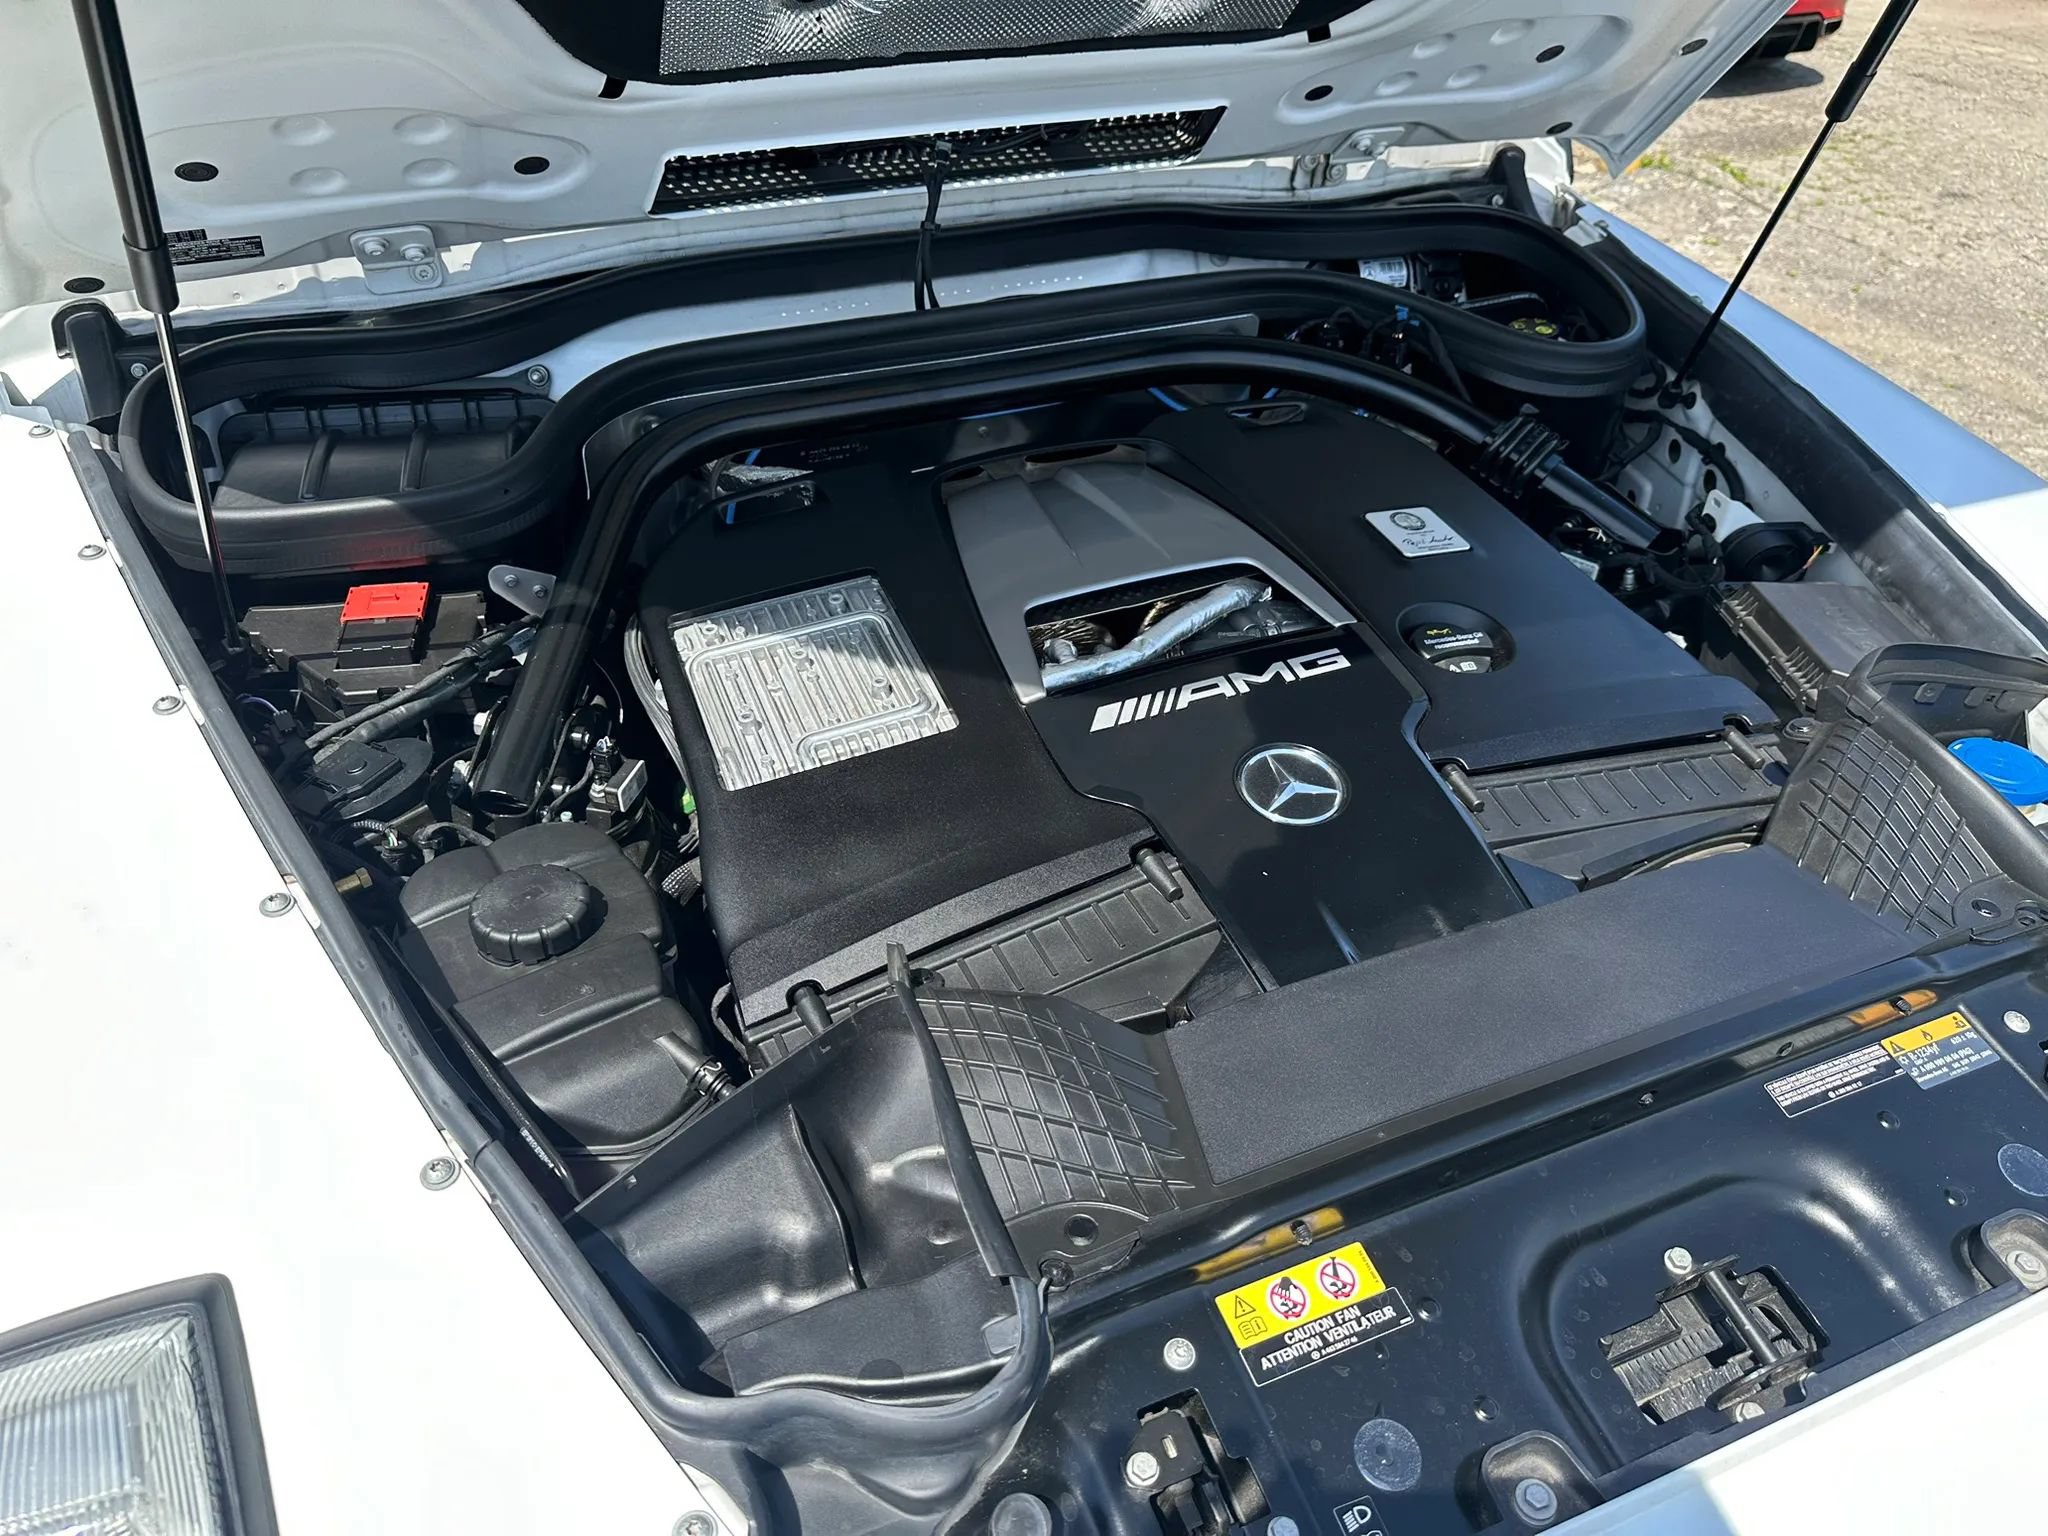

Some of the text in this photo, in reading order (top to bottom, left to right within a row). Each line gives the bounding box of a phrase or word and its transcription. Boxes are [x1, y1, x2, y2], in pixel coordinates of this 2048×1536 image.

[1423, 634, 1473, 645] Mercedes-Benz
[1434, 638, 1480, 650] recommended
[1176, 648, 1351, 711] AMG
[1907, 1042, 1941, 1060] R-1234yf
[1260, 1305, 1397, 1371] ATTENTION VENTILATEUR
[1283, 1305, 1362, 1345] CAUTION FAN
